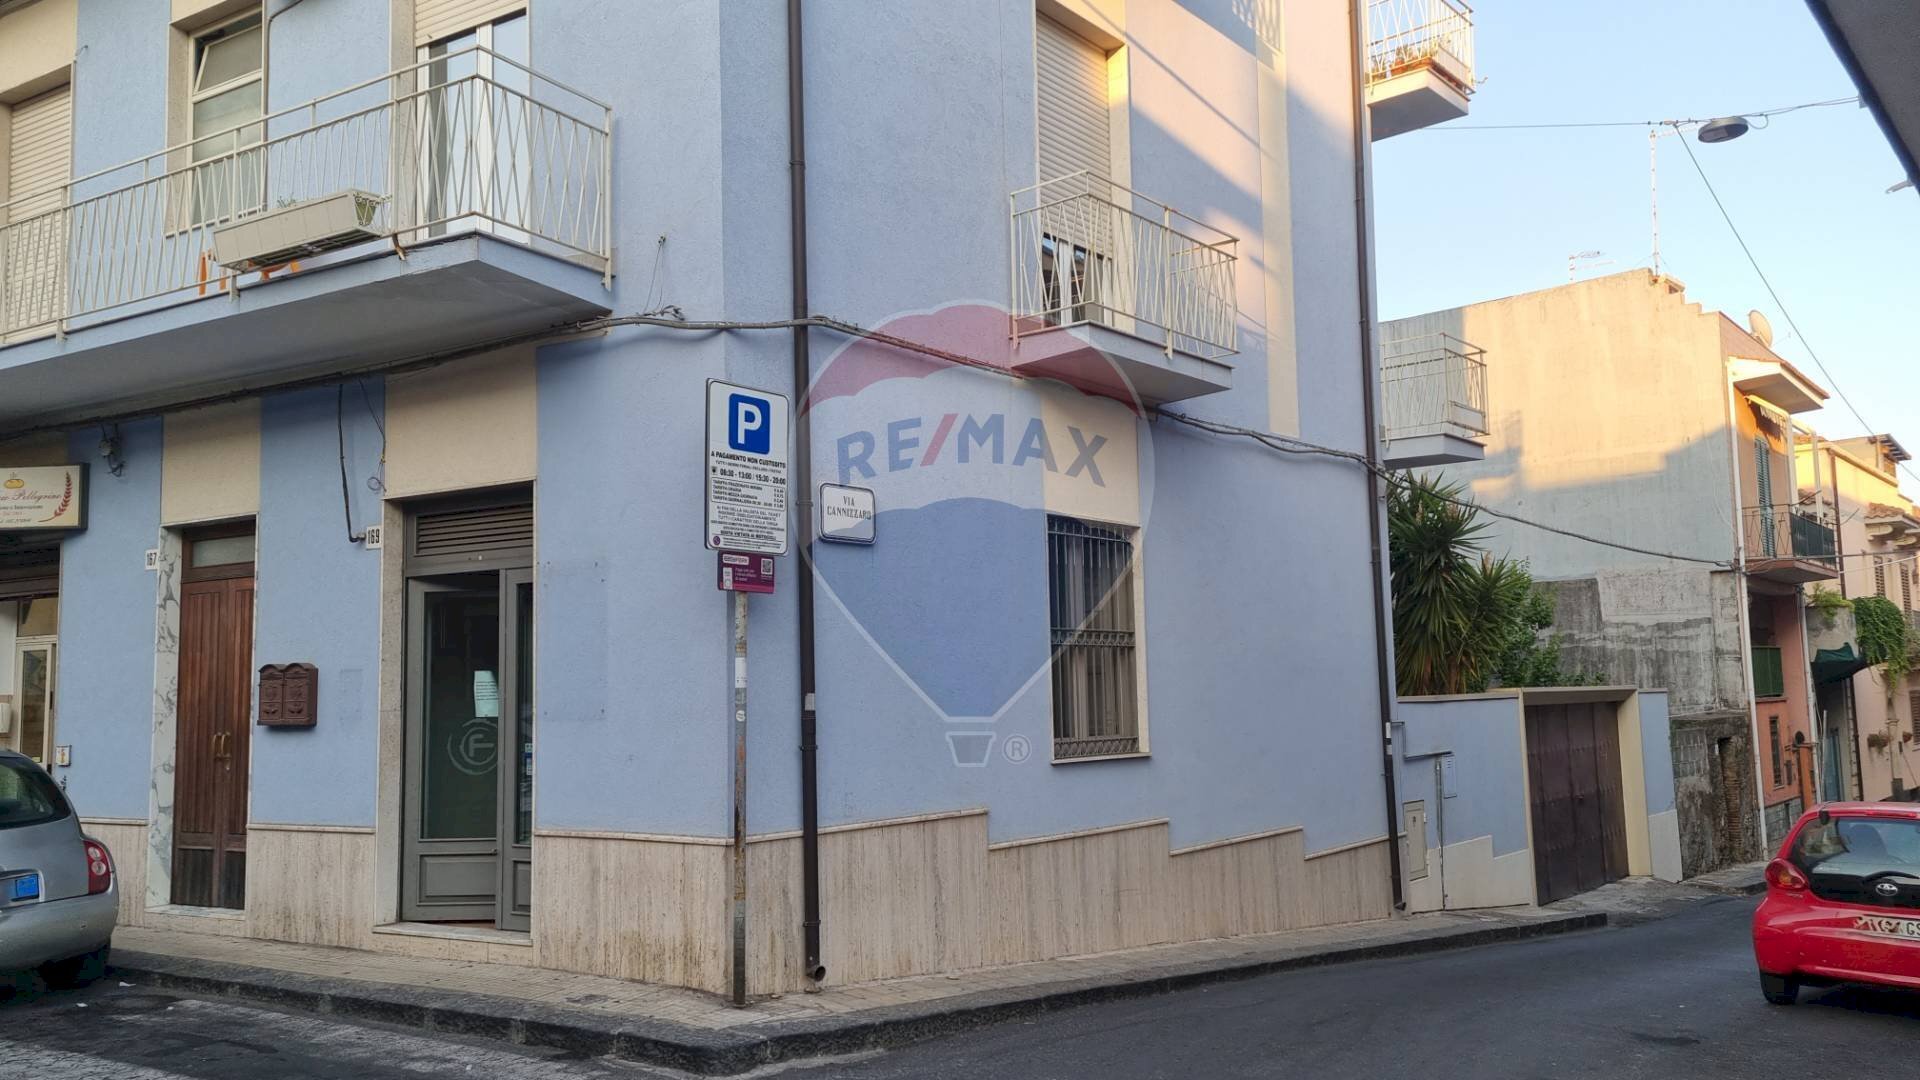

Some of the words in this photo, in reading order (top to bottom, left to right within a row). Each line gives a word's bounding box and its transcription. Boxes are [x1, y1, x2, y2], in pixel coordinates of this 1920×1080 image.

[737, 402, 762, 444] P
[716, 451, 746, 462] PAGAMENTO
[843, 496, 855, 506] VIA
[368, 528, 380, 544] 169
[146, 552, 157, 566] 167
